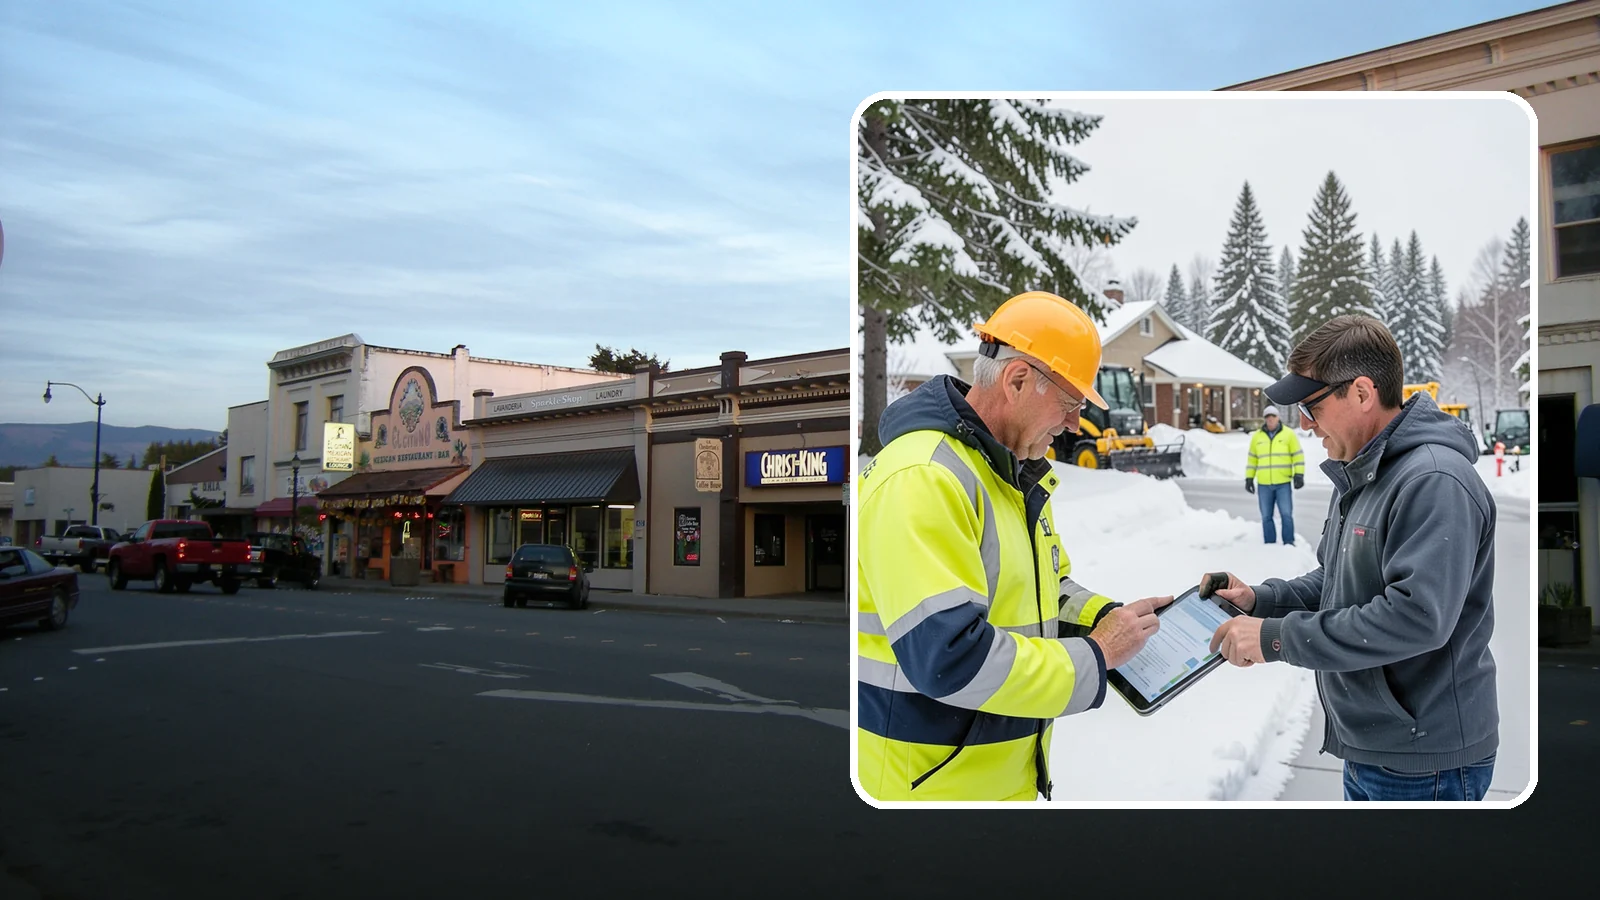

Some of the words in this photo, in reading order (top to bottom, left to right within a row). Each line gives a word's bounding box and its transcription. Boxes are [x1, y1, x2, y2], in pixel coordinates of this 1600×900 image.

[595, 389, 624, 400] LAUNDRY
[493, 402, 523, 412] LAVANDERIA
[530, 397, 560, 408] Sparkle
[561, 394, 583, 404] Shop
[398, 451, 433, 462] RESTAURANT
[438, 450, 450, 459] BAR
[761, 452, 797, 478] CHRIST
[799, 450, 827, 476] KING
